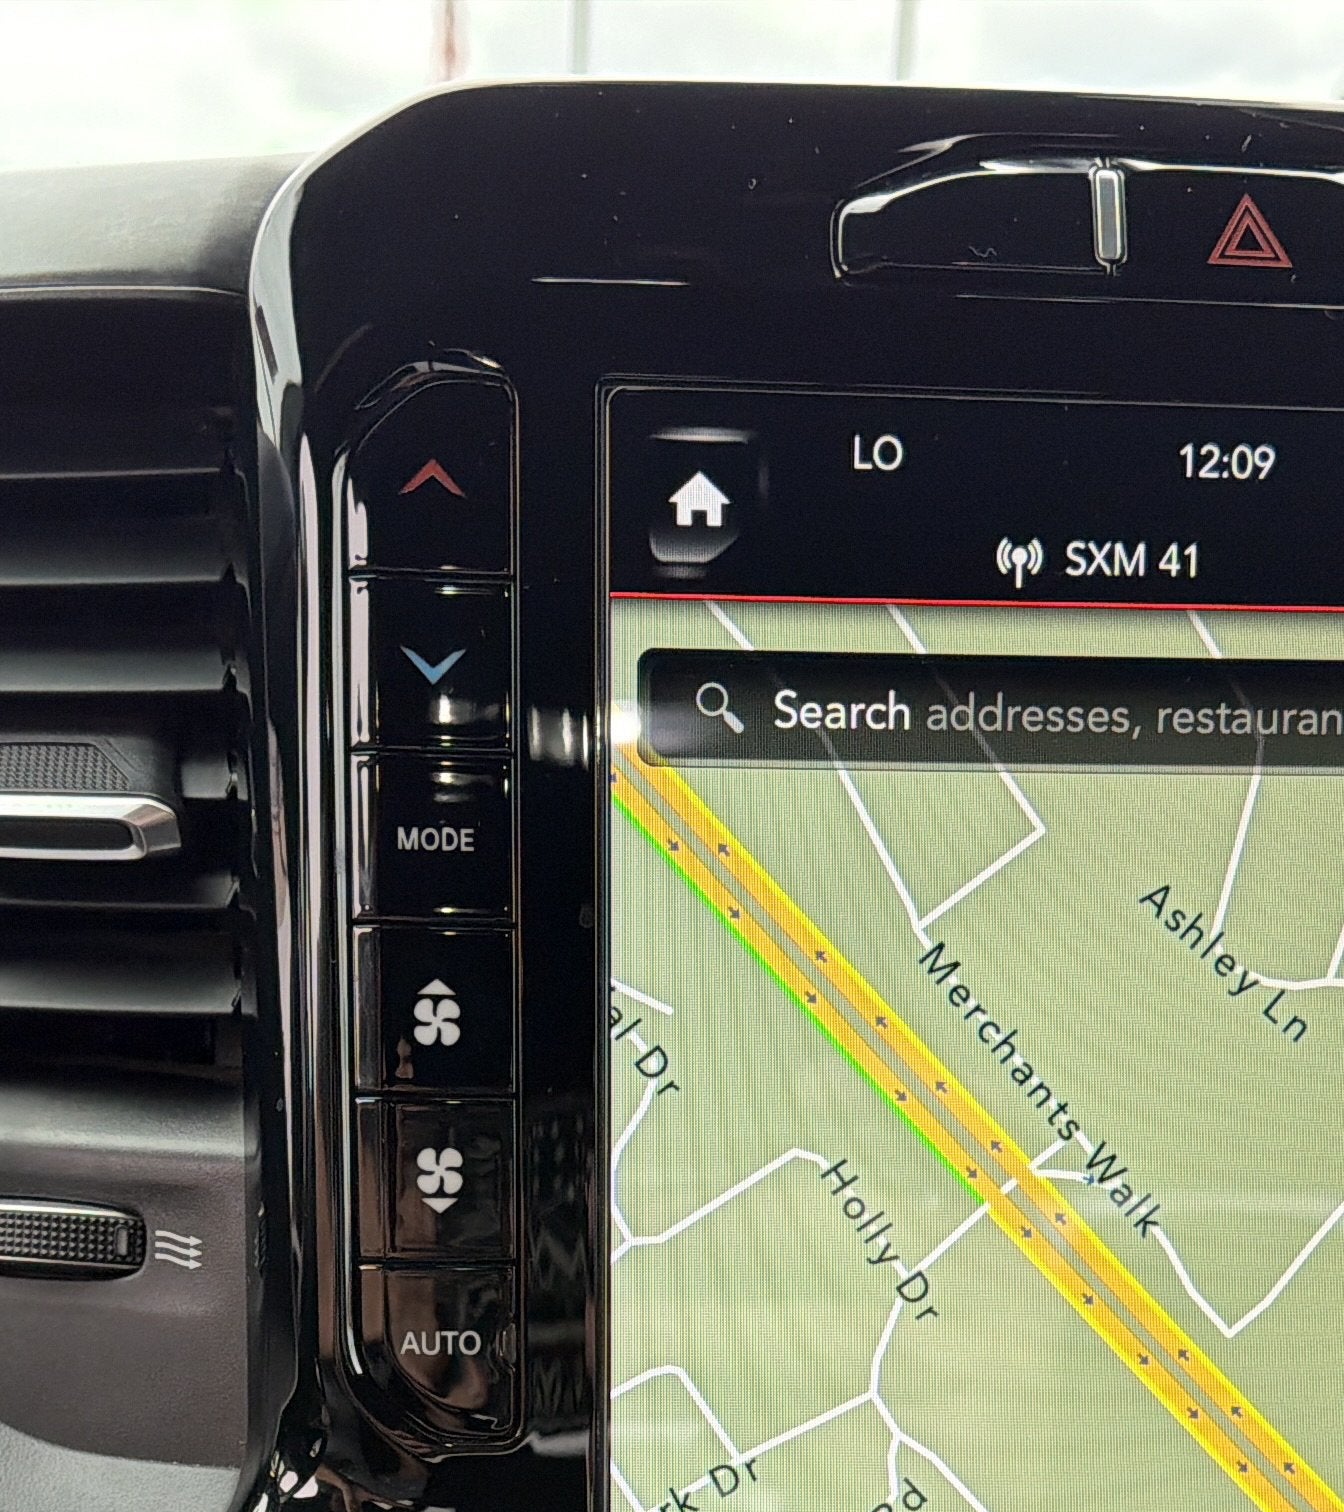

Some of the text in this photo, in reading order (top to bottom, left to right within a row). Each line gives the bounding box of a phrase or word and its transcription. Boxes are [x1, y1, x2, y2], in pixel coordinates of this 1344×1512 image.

[853, 435, 903, 471] LO
[1179, 442, 1276, 480] 12:09
[1065, 540, 1198, 578] SXM 41
[773, 689, 911, 731] Search
[926, 692, 1141, 739] addresses,
[397, 826, 475, 852] MODE
[1138, 882, 1308, 1044] Ashley Ln
[634, 1045, 680, 1096] Dr
[919, 941, 1159, 1240] Merchants Walk
[821, 1158, 939, 1323] Holly Dr
[400, 1330, 481, 1356] AUTO
[709, 1458, 757, 1498] Dr
